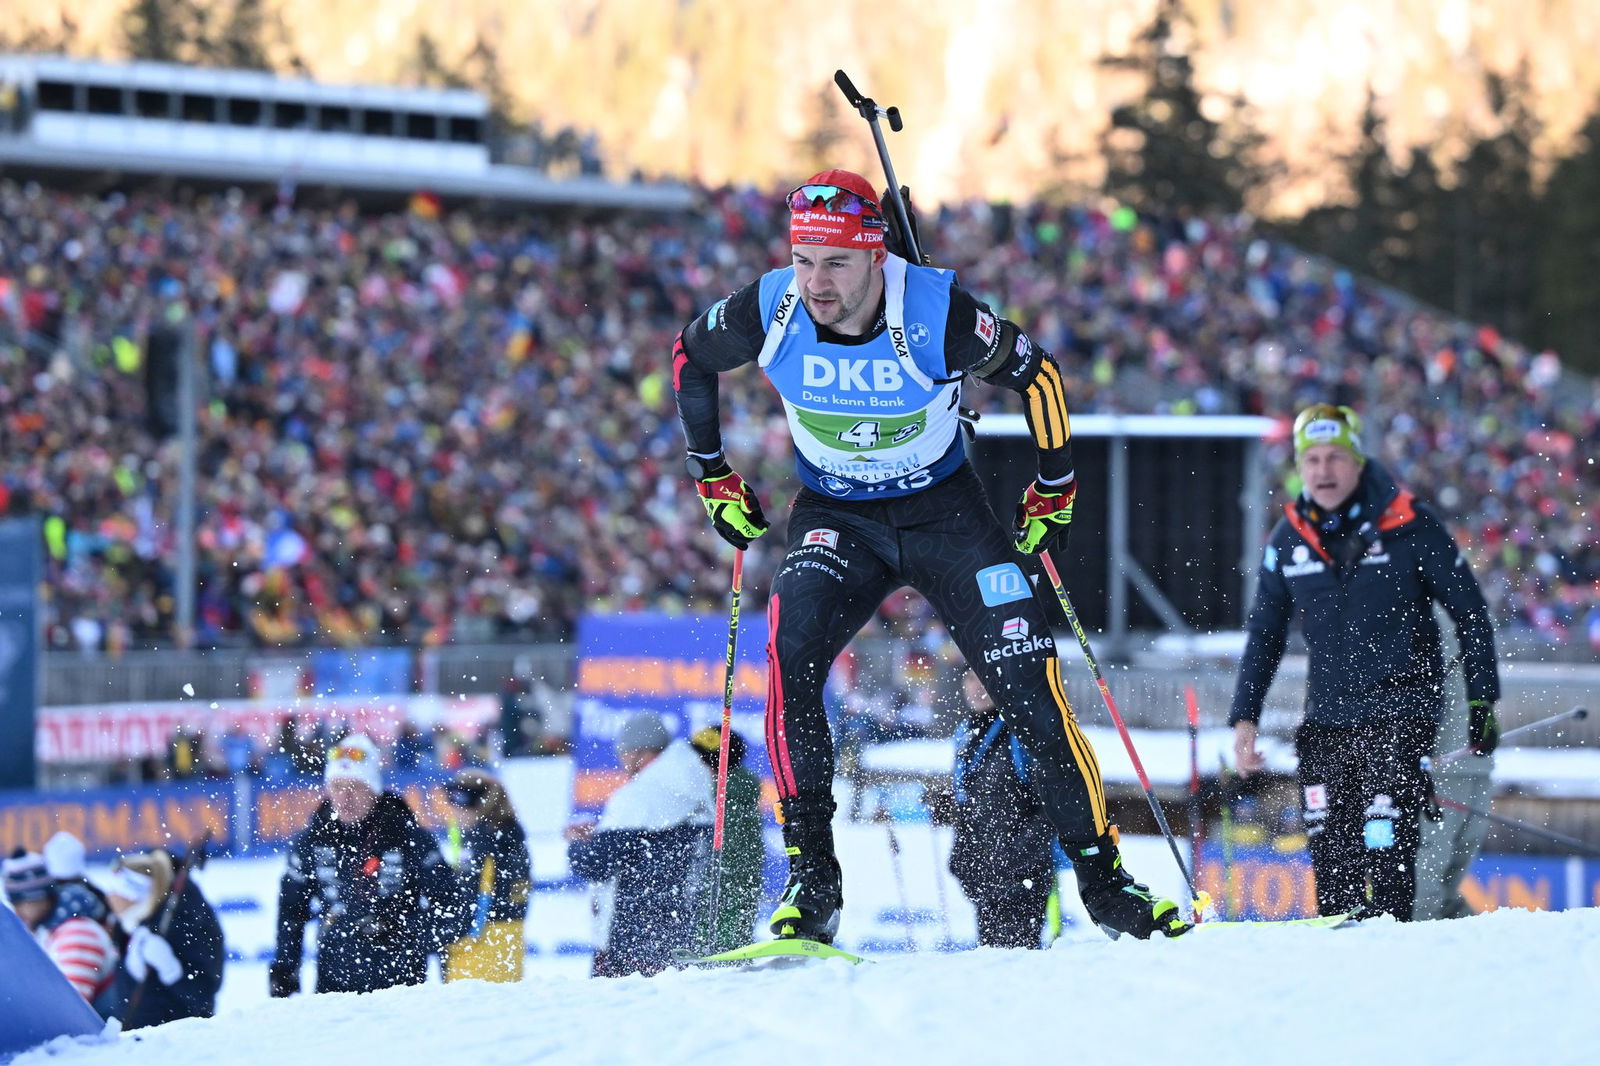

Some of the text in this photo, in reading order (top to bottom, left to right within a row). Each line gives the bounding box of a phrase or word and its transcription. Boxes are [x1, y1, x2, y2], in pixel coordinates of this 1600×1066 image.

[774, 292, 795, 327] JOKA
[890, 326, 909, 358] JOKA
[802, 354, 904, 392] DKB
[802, 390, 905, 407] Das kann Bank
[836, 420, 881, 449] 4
[786, 546, 849, 568] Kaufland
[794, 560, 845, 583] TERREX
[984, 635, 1053, 664] tectake
